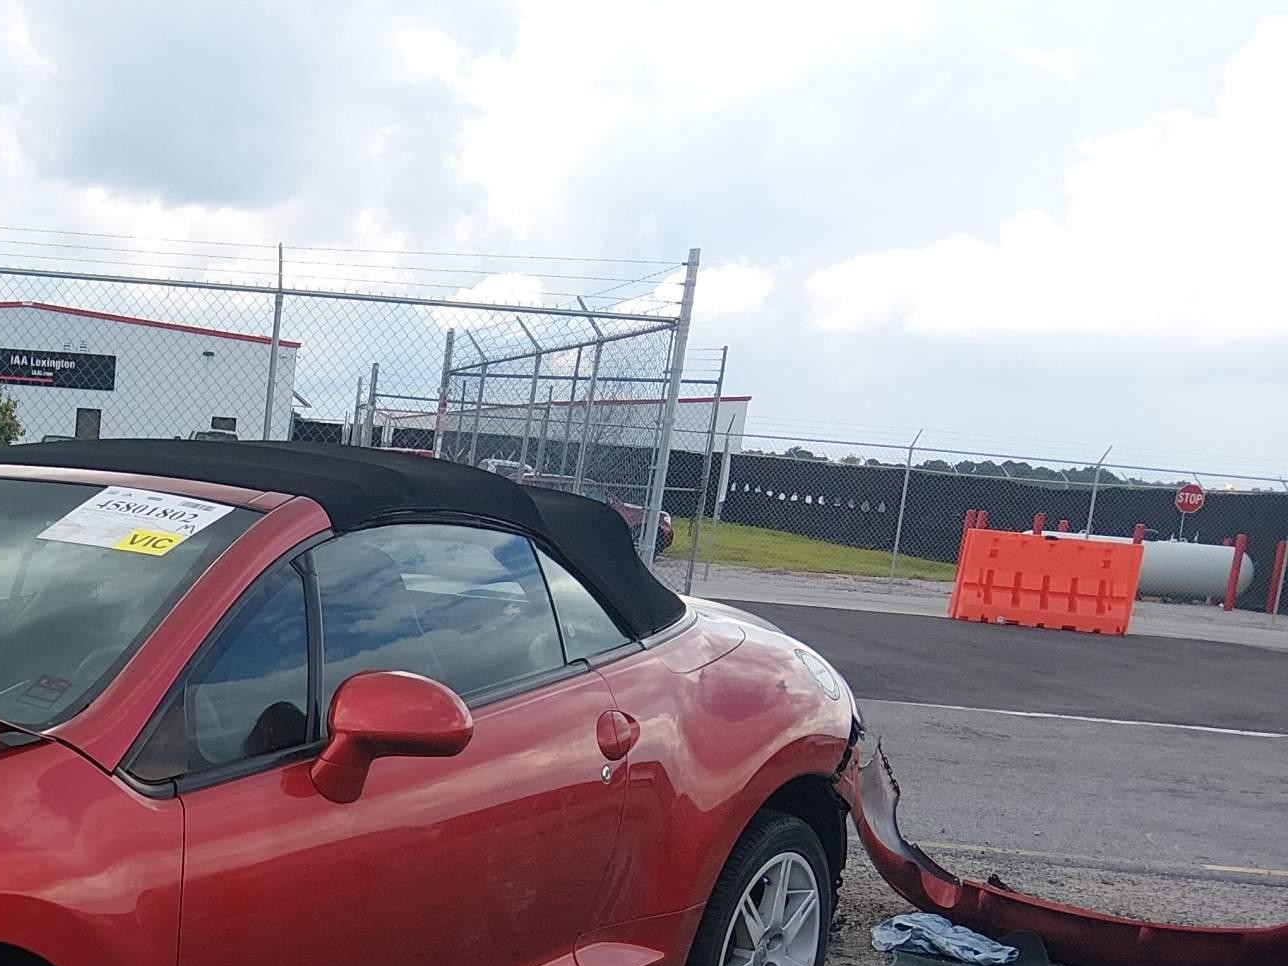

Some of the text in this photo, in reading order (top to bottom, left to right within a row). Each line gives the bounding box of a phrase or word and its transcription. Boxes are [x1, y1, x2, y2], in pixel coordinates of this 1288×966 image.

[10, 354, 76, 371] IAA Lexington
[1177, 492, 1203, 505] STOP
[96, 499, 199, 523] 45801802
[128, 534, 173, 549] VIC
